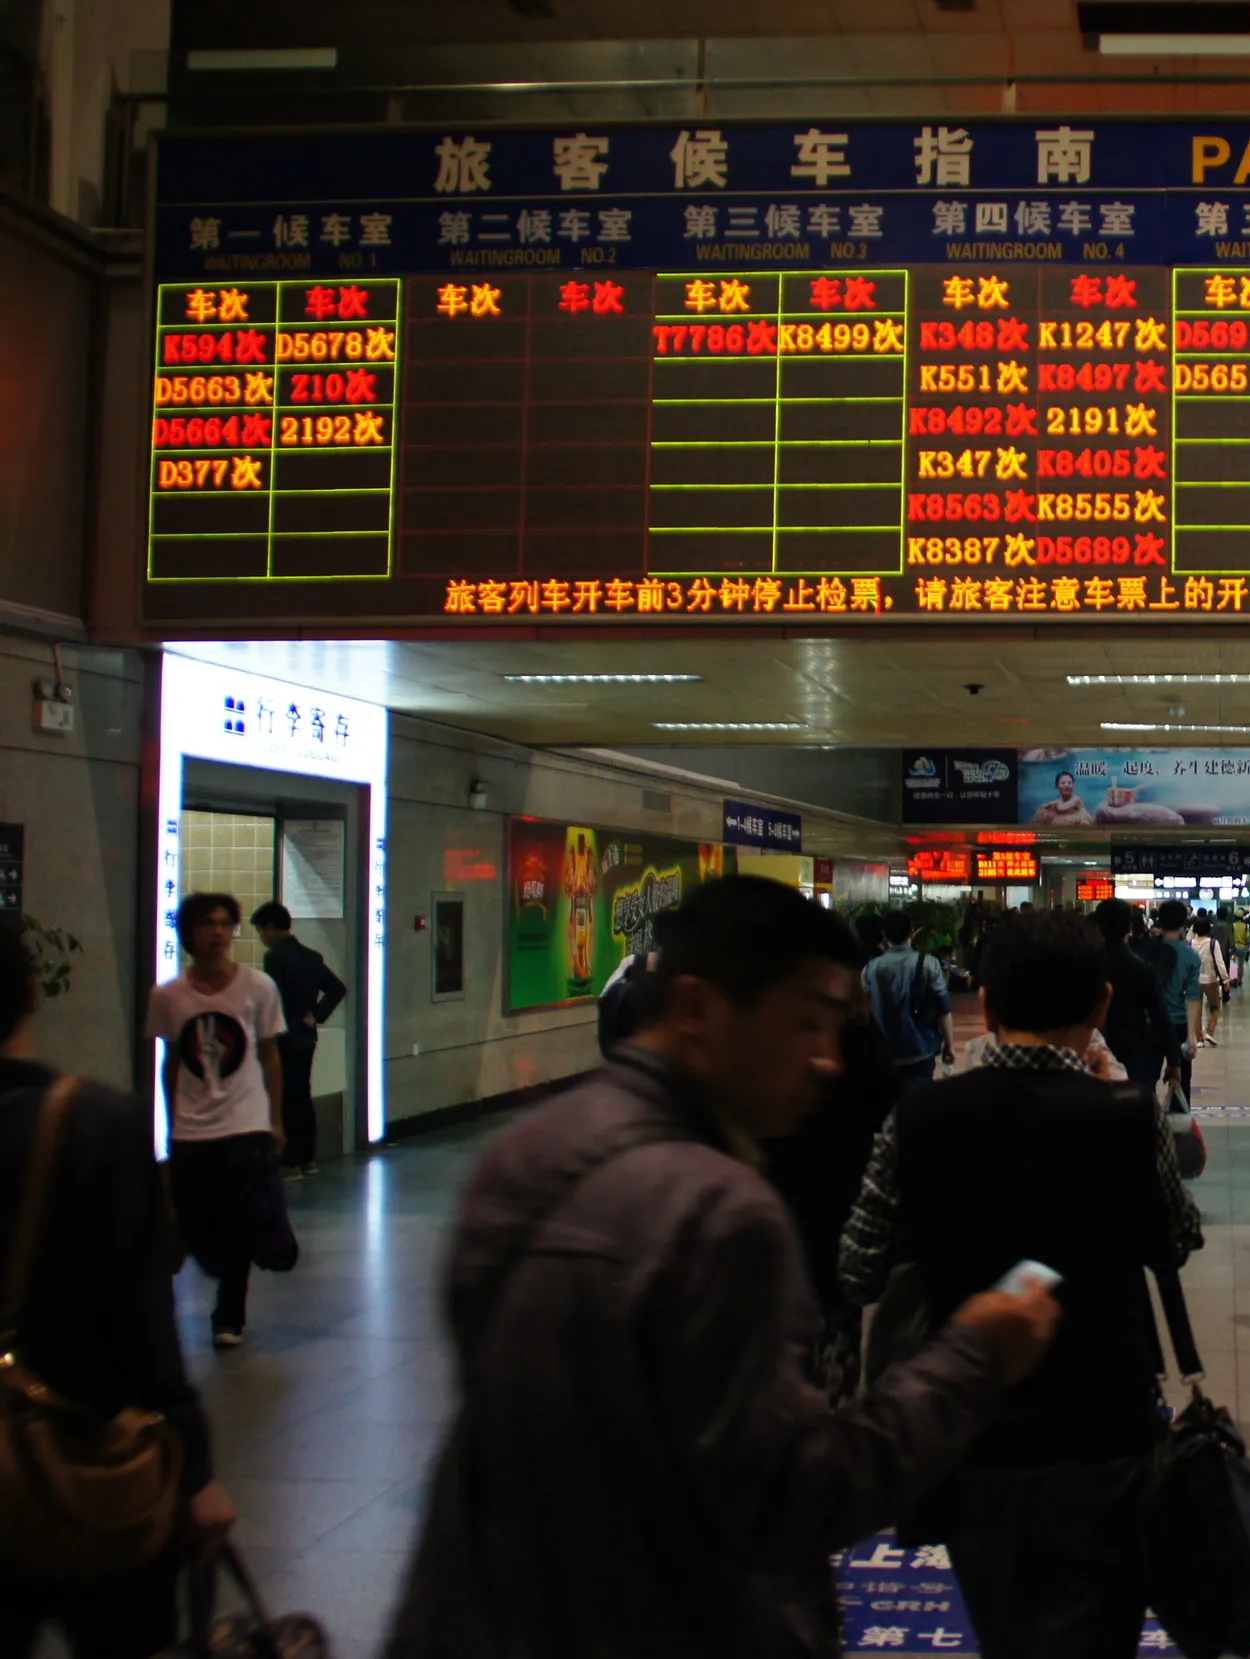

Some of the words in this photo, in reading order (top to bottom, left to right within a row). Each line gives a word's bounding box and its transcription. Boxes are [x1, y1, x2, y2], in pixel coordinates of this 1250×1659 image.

[434, 126, 1094, 193] 旅客候车指南
[189, 213, 393, 249] 第一候车室
[437, 209, 632, 245] 第二候车室
[683, 204, 884, 239] 第三候车室
[932, 200, 1135, 236] 第四候车室
[205, 251, 310, 270] WAITINGROOM
[450, 248, 560, 267] WAITINGROOM
[581, 247, 616, 265] NO.2
[696, 243, 810, 261] WAITINGROOM
[831, 242, 867, 260] NO.3
[947, 242, 1062, 260] WAITINGROOM
[186, 289, 248, 322] 车次
[305, 286, 368, 319] 车次
[437, 283, 501, 316] 车次
[559, 280, 624, 313] 车次
[685, 279, 750, 312] 车次
[810, 276, 876, 310] 车次
[943, 276, 1008, 309] 车次
[1070, 274, 1137, 308] 车次
[163, 329, 267, 364] K594次
[277, 326, 394, 361] D5678次
[653, 320, 777, 354] T7786次
[779, 319, 903, 352] K8499次
[920, 318, 1028, 350] K348次
[1039, 318, 1166, 350] K1247次
[155, 372, 272, 404] D5663次
[291, 368, 376, 403] Z10次
[920, 360, 1028, 393] K551次
[1038, 360, 1166, 392] K8497次
[154, 413, 271, 447] D5664次
[281, 411, 383, 445] 2192次
[910, 403, 1037, 436] K8492次
[1047, 403, 1156, 436] 2191次
[159, 456, 261, 489] D377次
[919, 446, 1028, 479] K347次
[1038, 446, 1166, 478] K8405次
[908, 489, 1037, 522] K8563次
[1038, 489, 1166, 521] K8555次
[908, 532, 1036, 566] K8387次
[1036, 532, 1166, 566] D5689次
[257, 696, 350, 748] 行李寄存
[1228, 851, 1239, 865] 6
[870, 1600, 951, 1612] CRH
